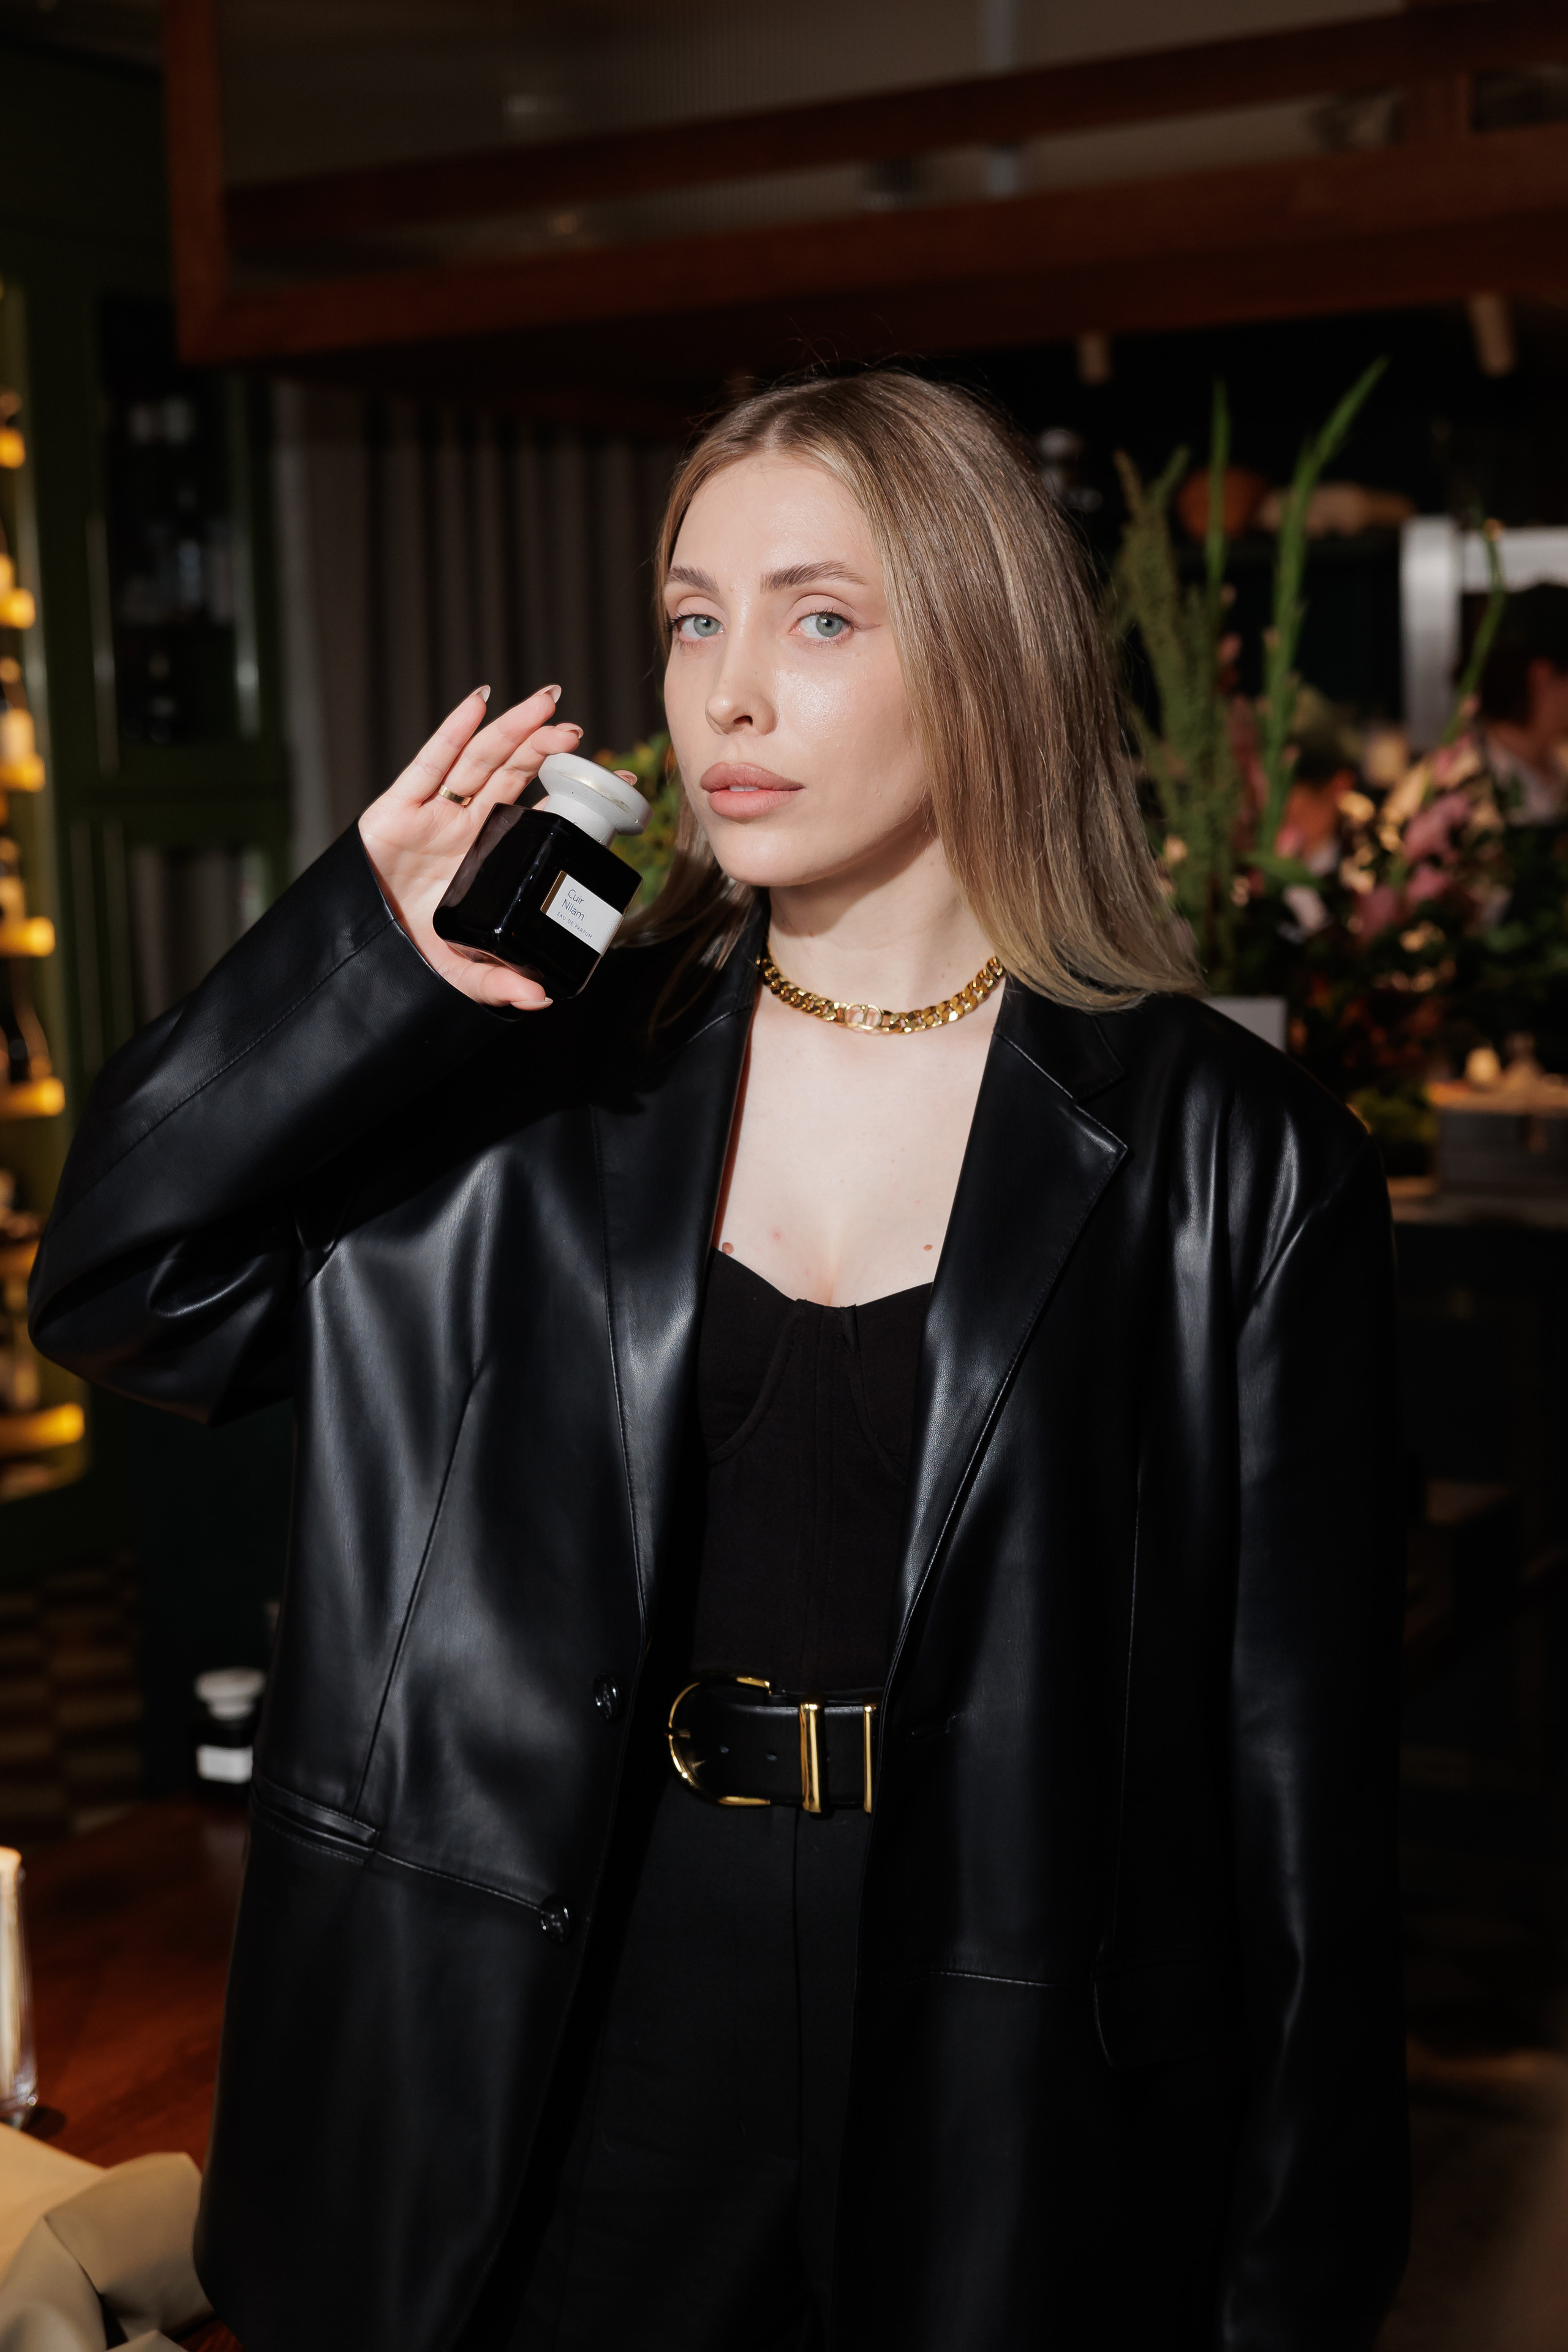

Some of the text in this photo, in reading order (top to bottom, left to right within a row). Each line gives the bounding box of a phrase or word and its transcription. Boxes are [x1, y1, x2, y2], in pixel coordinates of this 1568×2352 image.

[568, 889, 584, 905] Cuir
[562, 899, 584, 921] Nilam
[557, 911, 567, 921] EAU
[575, 924, 592, 939] PARFUM
